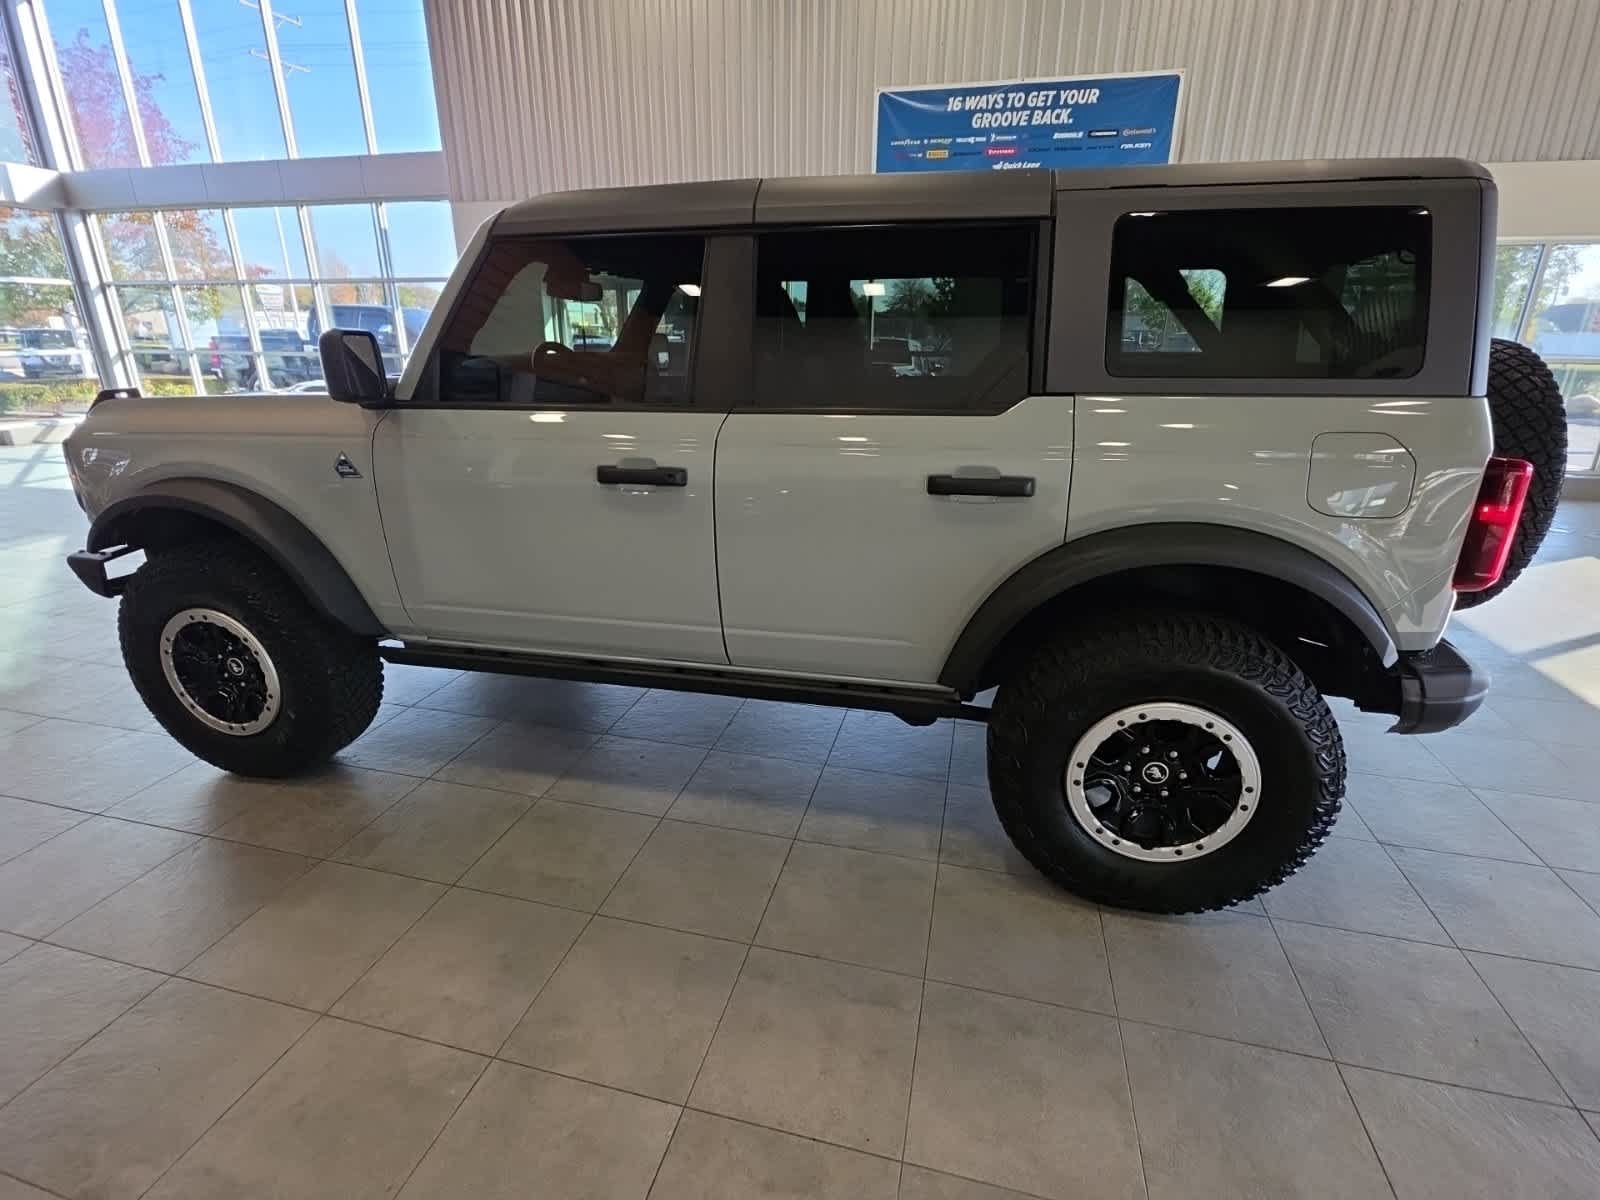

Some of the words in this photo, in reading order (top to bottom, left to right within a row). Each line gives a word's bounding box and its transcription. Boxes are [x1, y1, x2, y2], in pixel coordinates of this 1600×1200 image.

[947, 96, 962, 112] 16
[965, 93, 1004, 111] WAYS
[1007, 92, 1026, 109] TO
[1027, 90, 1057, 108] GET
[1059, 88, 1100, 105] YOUR
[971, 110, 1030, 128] GROOVE
[1031, 108, 1074, 125] BACK.
